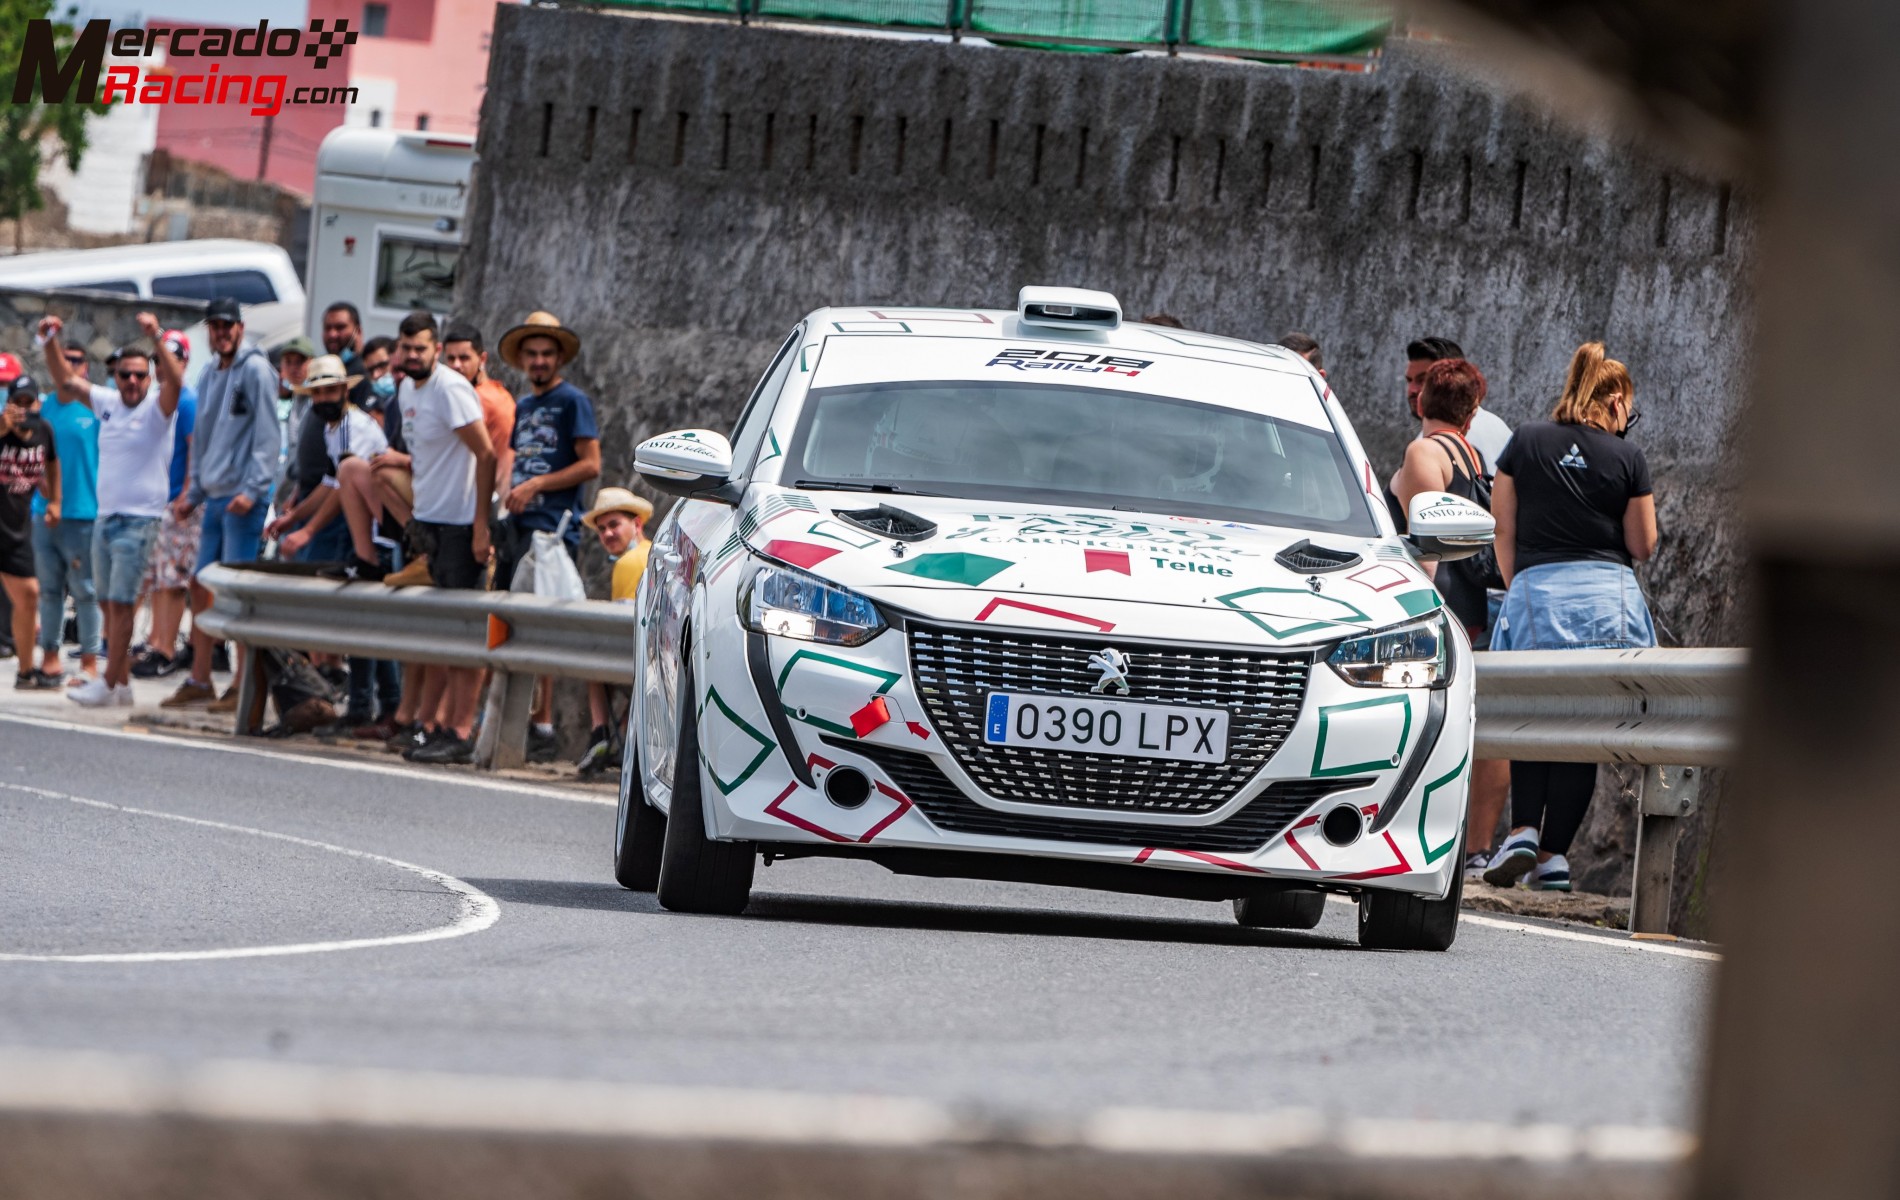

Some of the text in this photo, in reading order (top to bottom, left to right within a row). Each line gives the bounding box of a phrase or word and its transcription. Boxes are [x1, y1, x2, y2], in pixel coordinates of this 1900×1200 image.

[995, 348, 1155, 370] 208
[640, 441, 675, 449] PASTO
[1418, 507, 1456, 520] PASTO
[980, 536, 1233, 563] CARNICERIAS
[1150, 557, 1235, 578] Telde
[993, 723, 1001, 734] E
[1016, 703, 1217, 755] 0390 LPX
